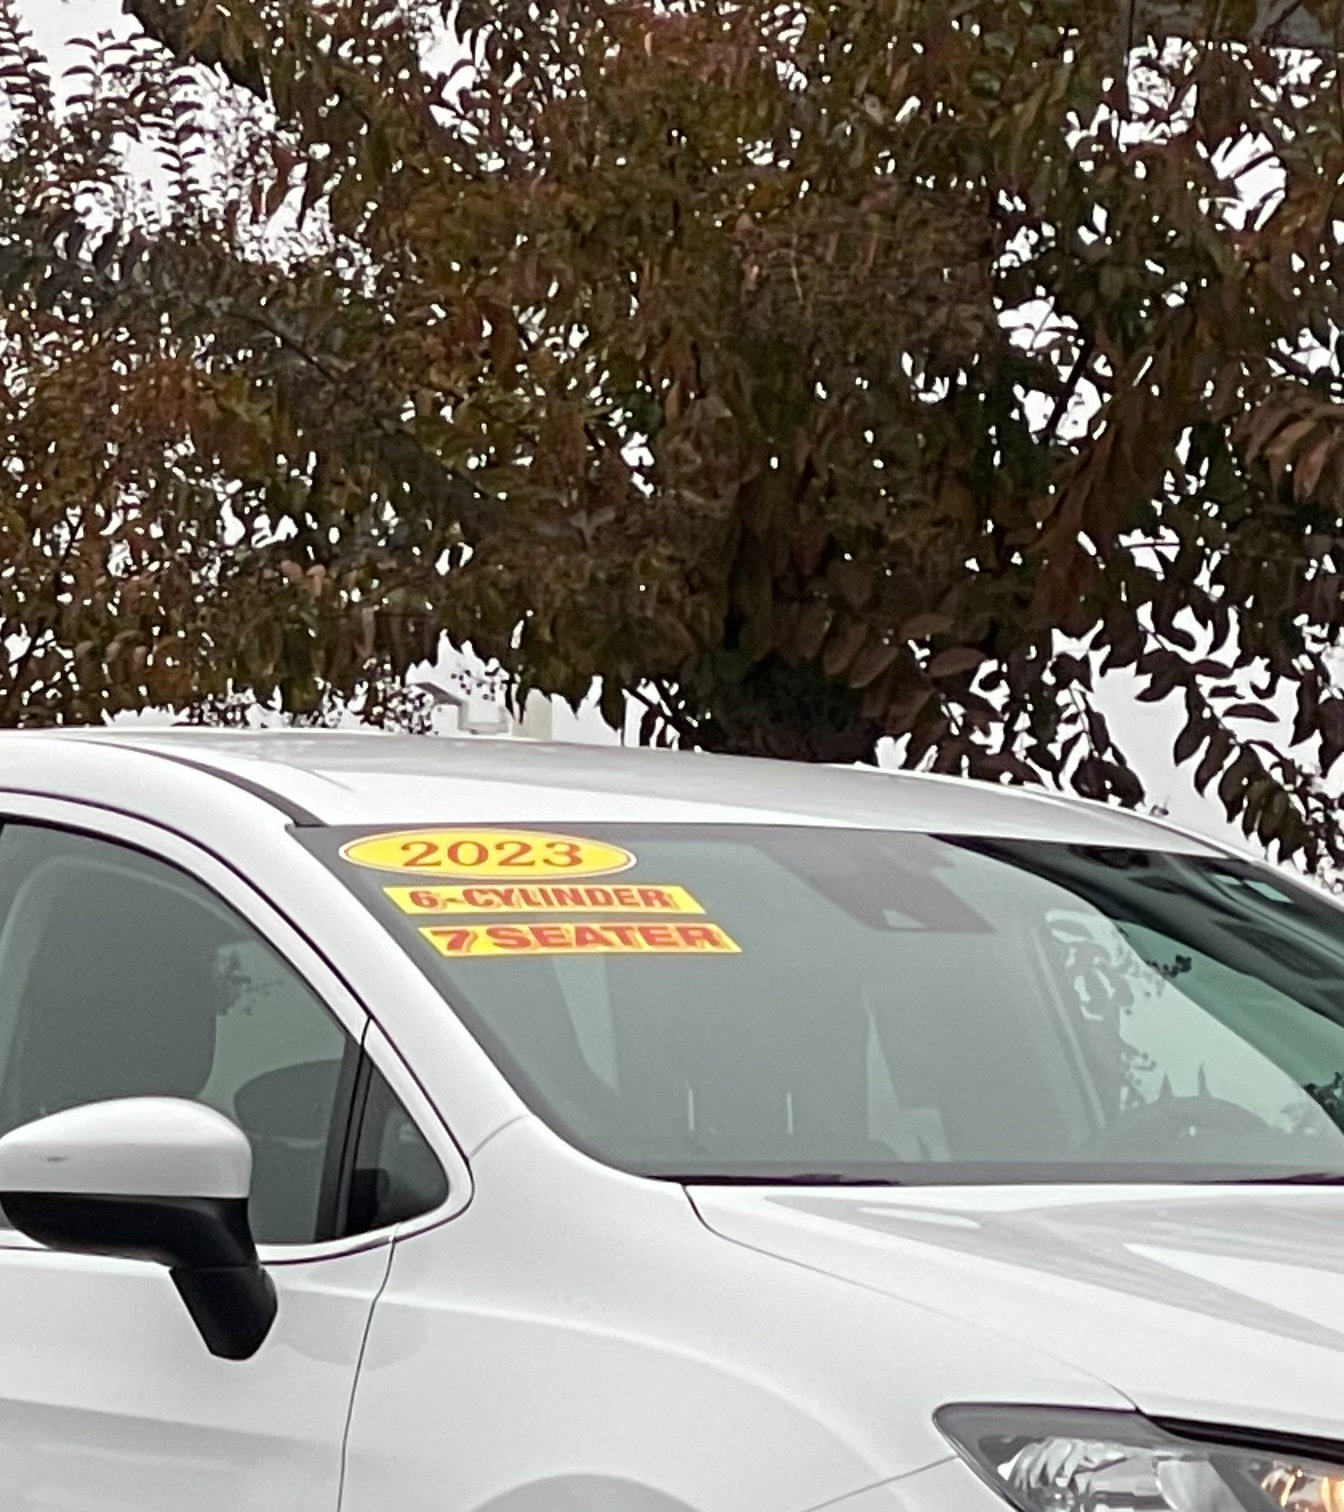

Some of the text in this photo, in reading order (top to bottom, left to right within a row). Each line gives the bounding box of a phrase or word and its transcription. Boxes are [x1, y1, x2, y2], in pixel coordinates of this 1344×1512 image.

[400, 840, 584, 868] 2023
[408, 887, 677, 911] 6-CYLINDER
[430, 923, 730, 952] 7 SEATER
